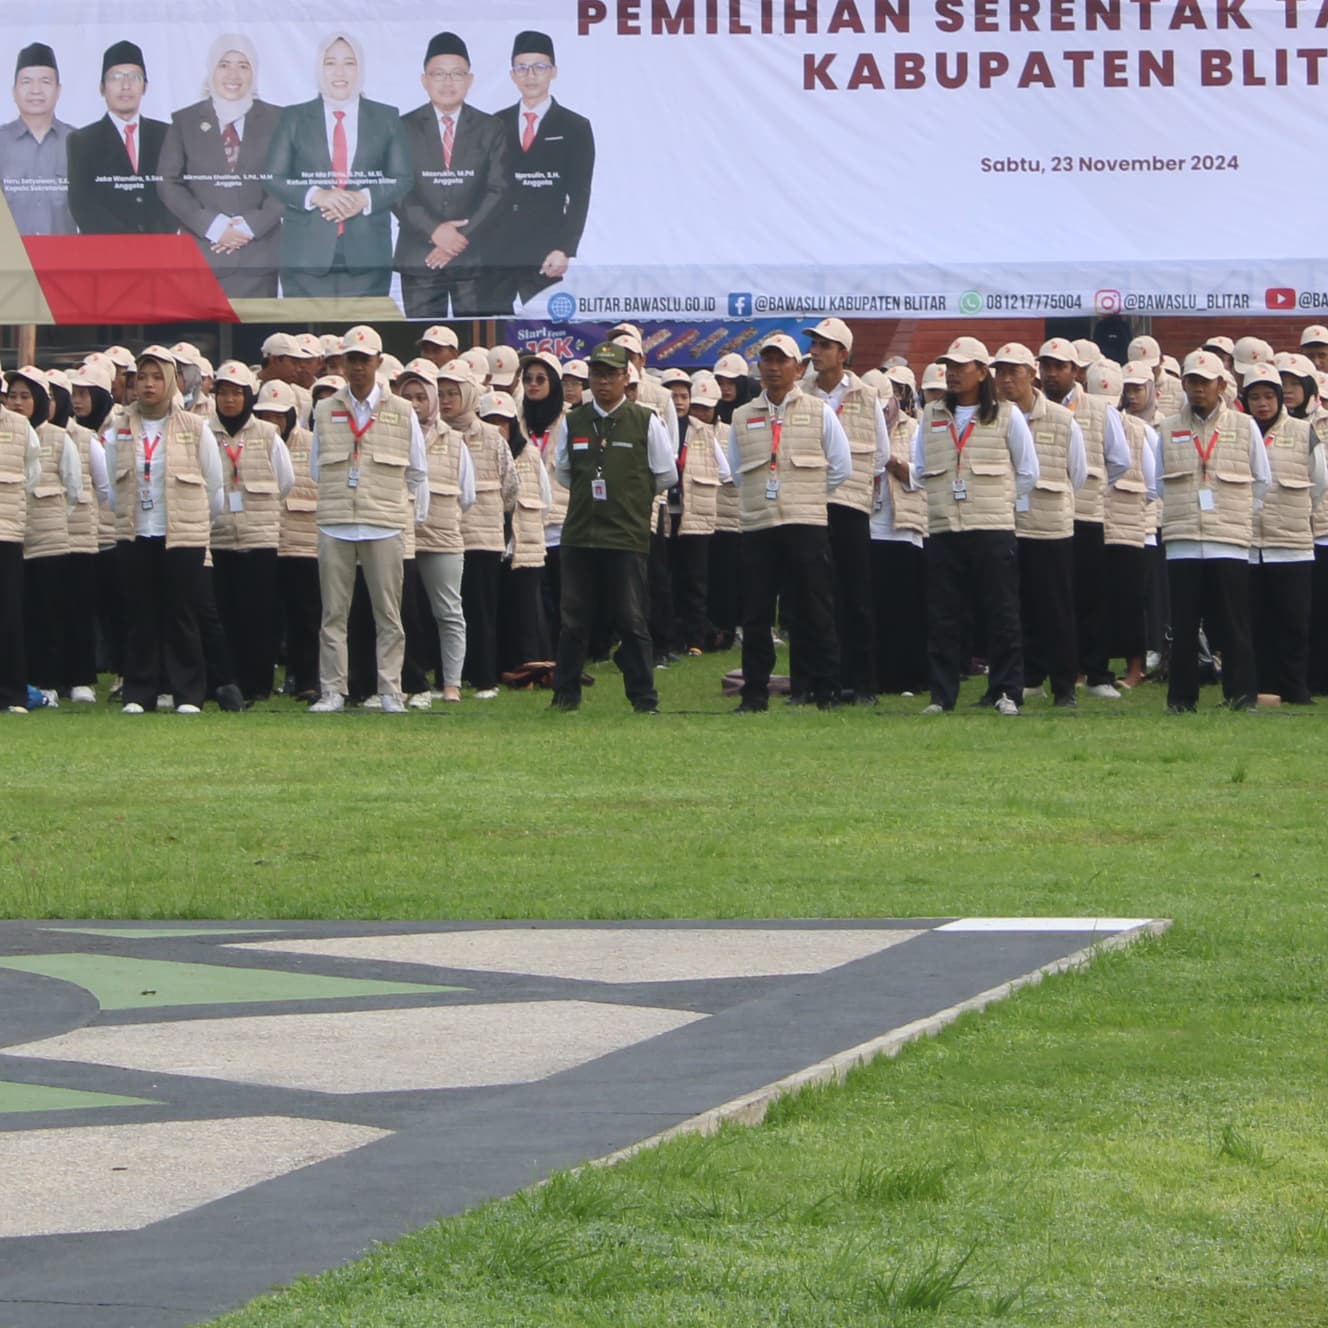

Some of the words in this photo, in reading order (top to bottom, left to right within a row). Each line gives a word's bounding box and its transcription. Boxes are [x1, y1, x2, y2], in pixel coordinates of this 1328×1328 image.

[802, 49, 1175, 91] KABUPATEN
[980, 157, 1045, 174] Sabtu,
[1051, 156, 1073, 172] 23
[1079, 155, 1186, 172] November
[1191, 155, 1239, 171] 2024
[578, 296, 716, 313] BLITAR.BAWASLU.GO.ID
[754, 295, 825, 313] @BAWASLU
[829, 295, 900, 312] KABUPATEN
[904, 295, 946, 312] BLITAR
[986, 294, 1082, 311] 081217775004
[1123, 293, 1250, 312] @BAWASLU_BLITAR
[517, 327, 546, 341] Start
